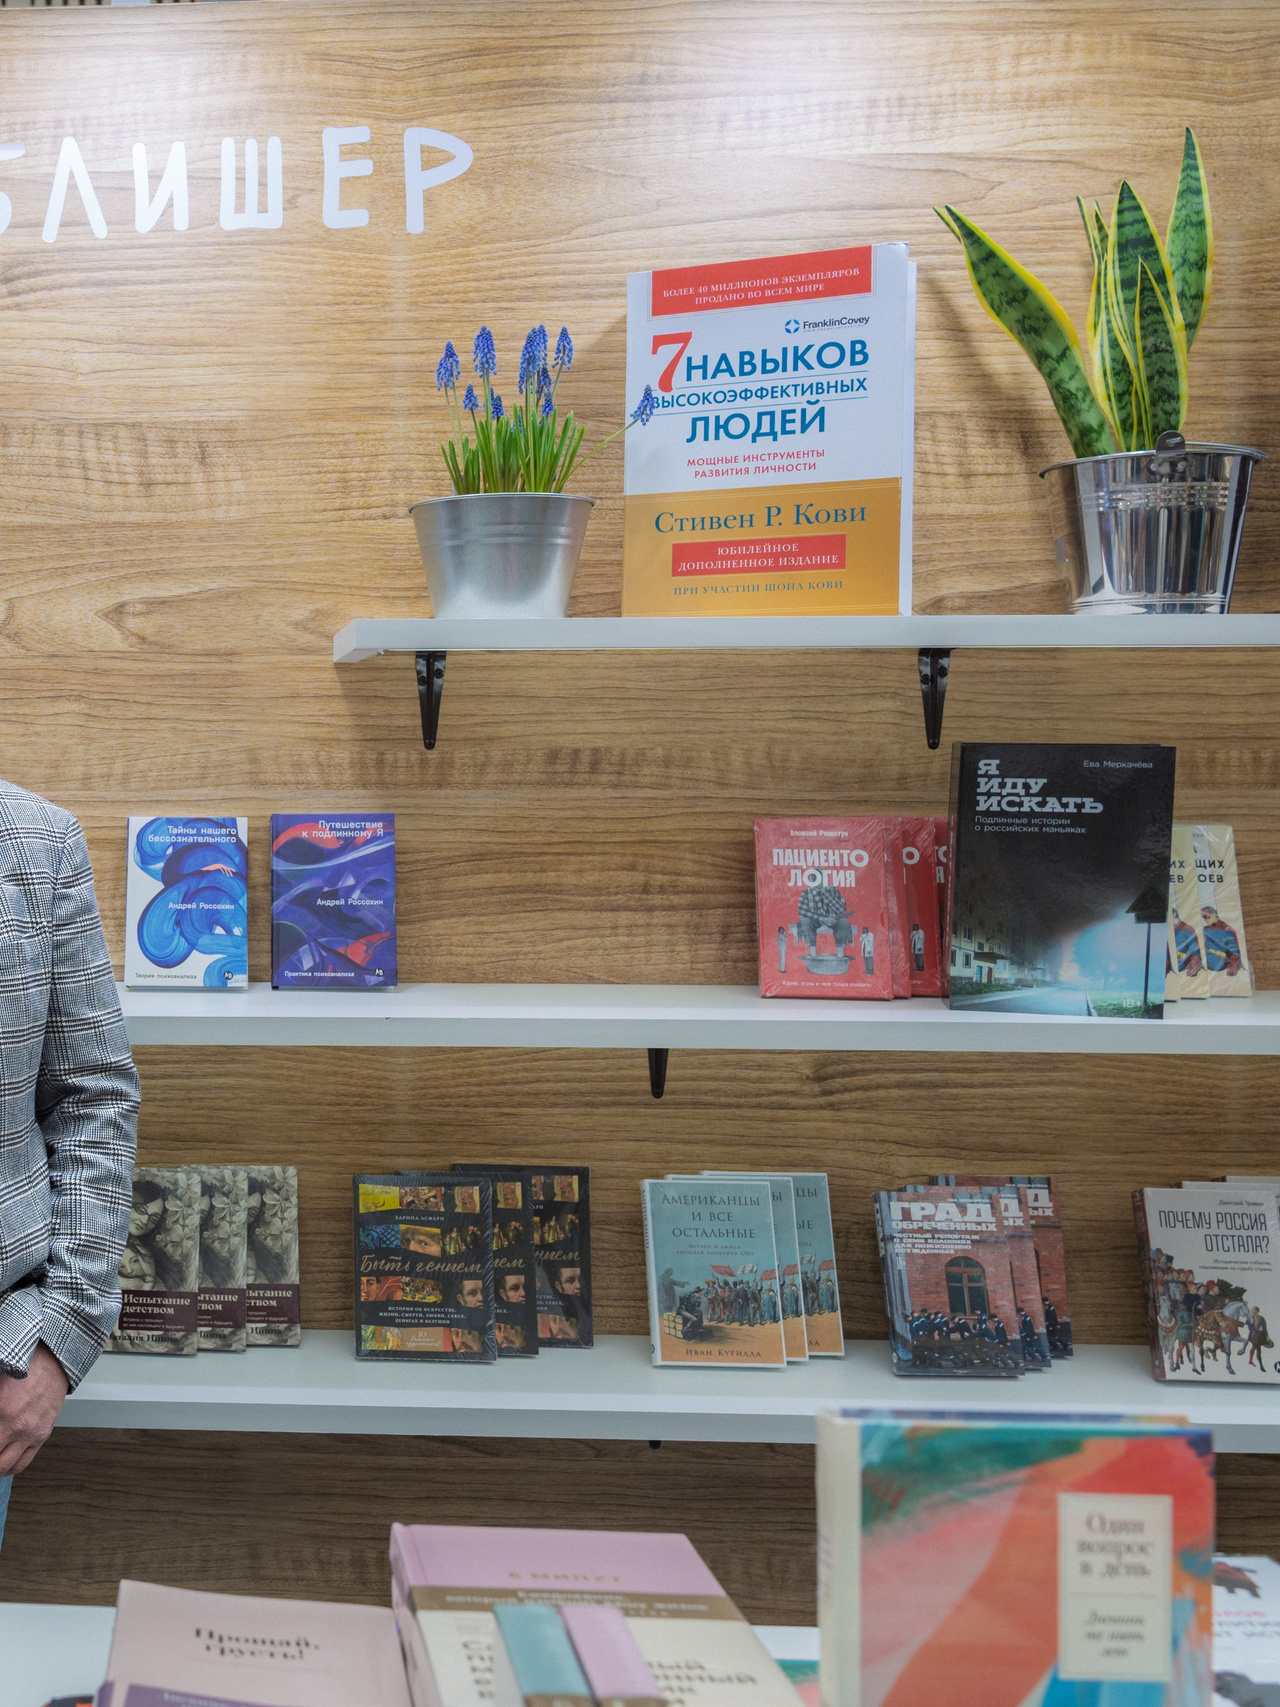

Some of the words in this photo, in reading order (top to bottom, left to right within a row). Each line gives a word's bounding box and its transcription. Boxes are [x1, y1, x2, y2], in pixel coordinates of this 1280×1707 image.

[663, 286, 695, 298] БОЛЕЕ
[697, 285, 709, 294] 40
[710, 276, 779, 292] МИЛЛИОНОВ
[781, 268, 860, 285] ЭКЗЕМПЛЯРОВ
[695, 291, 745, 305] ПРОДАНО
[748, 289, 762, 299] ВО
[765, 286, 793, 297] ВСЕМ
[795, 283, 826, 294] МИРЕ
[803, 316, 870, 329] FranklinCovey
[651, 331, 692, 393] 7
[686, 339, 870, 382] НАВЫКОВ
[685, 399, 825, 443] ЛЮДЕЙ
[687, 455, 739, 467] МОЩНЫЕ
[742, 449, 825, 463] ИНСТРУМЕНТЫ
[694, 466, 750, 479] РАЗВИТИЯ
[753, 462, 817, 475] ЛИЧНОСТИ
[655, 511, 755, 534] Стивен
[764, 505, 783, 527] Р.
[793, 502, 867, 526] Кови
[717, 541, 799, 556] ЮБИЛЕЙНОЕ
[678, 557, 775, 572] ДОПОЛНЕННОЕ
[778, 554, 839, 567] ИЗДАНИЕ
[674, 586, 699, 596] ПРИ
[702, 584, 760, 595] УЧАСТИИ
[765, 581, 804, 592] ШОНА
[808, 580, 843, 590] КОВИ
[977, 759, 1000, 775] Я
[1083, 760, 1100, 768] Ева
[1103, 760, 1153, 769] Меркачёва
[976, 777, 1047, 796] ИДУ
[975, 795, 1104, 814] ИСКАТЬ
[318, 820, 384, 831] Путешествие
[975, 816, 1028, 825] Подлинные
[1031, 817, 1070, 825] истории
[167, 826, 196, 836] Тайны
[200, 827, 237, 836] нашего
[312, 829, 372, 839] подлинному
[376, 828, 384, 837] Я
[984, 824, 1039, 833] российских
[1043, 826, 1086, 834] маньяках
[148, 834, 237, 843] бессознательного
[772, 848, 869, 869] ПАЦИЕНТО
[787, 868, 855, 887] ЛОГИЯ
[168, 901, 197, 910] Андрей
[199, 902, 235, 910] Россохин
[316, 898, 345, 907] Андрей
[348, 898, 384, 907] Россохин
[156, 973, 197, 981] психоанализа
[284, 970, 312, 979] Практика
[313, 970, 355, 979] психоанализа
[1122, 999, 1141, 1007] 18+
[661, 1193, 760, 1207] АМЕРИКАНЦЫ
[692, 1212, 702, 1221] И
[709, 1212, 733, 1222] ВСЕ
[890, 1201, 996, 1222] ГРАД
[891, 1221, 997, 1232] ОБРЕЧЕННЫХ
[1158, 1210, 1212, 1230] ПОЧЕМУ
[1215, 1212, 1267, 1231] РОССИЯ
[672, 1227, 755, 1239] ОСТАЛЬНЫЕ
[1204, 1234, 1270, 1254] ОТСТАЛА?
[360, 1254, 410, 1273] Быть
[415, 1261, 483, 1274] гением
[124, 1294, 191, 1306] Испытание
[123, 1305, 175, 1315] детством
